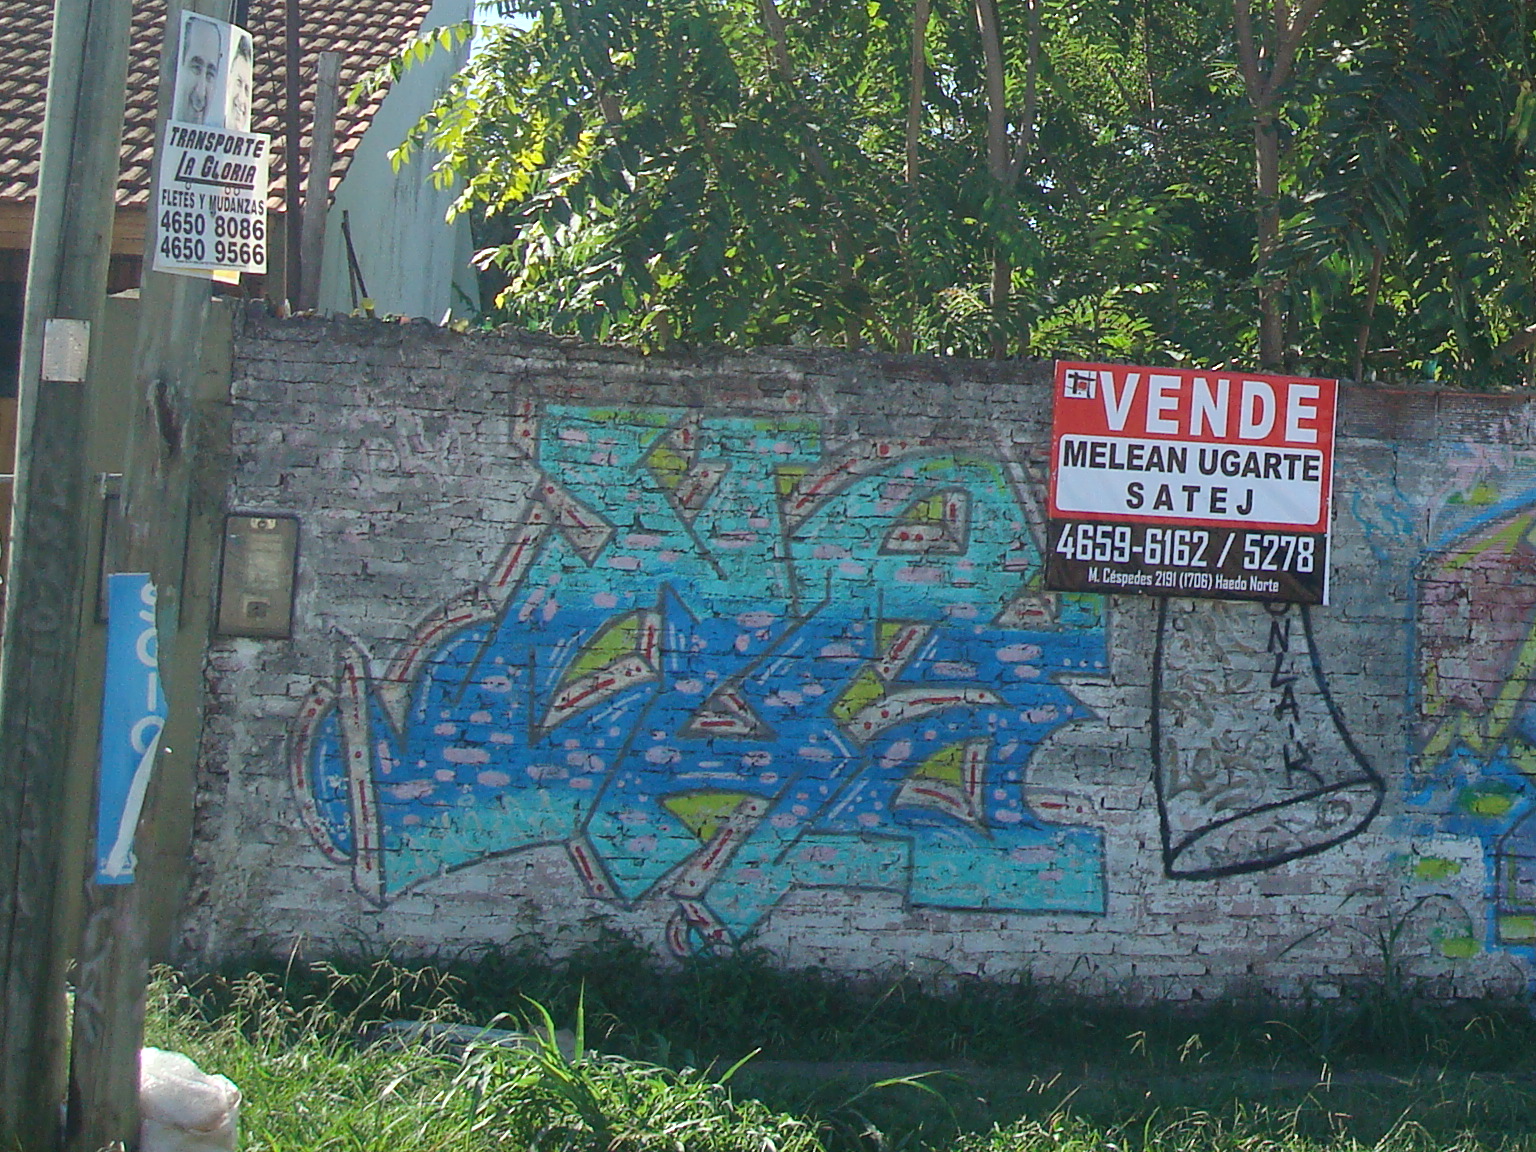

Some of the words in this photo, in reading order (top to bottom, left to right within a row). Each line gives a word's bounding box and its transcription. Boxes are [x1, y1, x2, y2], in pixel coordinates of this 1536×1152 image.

[170, 126, 265, 158] TRANSPORTE
[161, 189, 195, 209] FLETES
[199, 193, 206, 210] Y
[209, 194, 264, 216] MUDANZAS
[160, 210, 205, 236] 4650
[214, 215, 265, 241] 8086
[160, 235, 205, 261] 4650
[214, 240, 265, 265] 9566
[1099, 370, 1320, 443] VENDE
[1063, 440, 1188, 474] MELEAN
[1199, 448, 1321, 482] UGARTE
[1056, 523, 1209, 568] 4659-6162
[1243, 533, 1316, 574] 5278
[1088, 567, 1100, 583] M.
[1102, 567, 1153, 587] Céspedes
[1155, 571, 1176, 587] 2191
[1179, 571, 1213, 590] (1706)
[1215, 574, 1247, 591] Haedo
[1249, 576, 1280, 593] Norte
